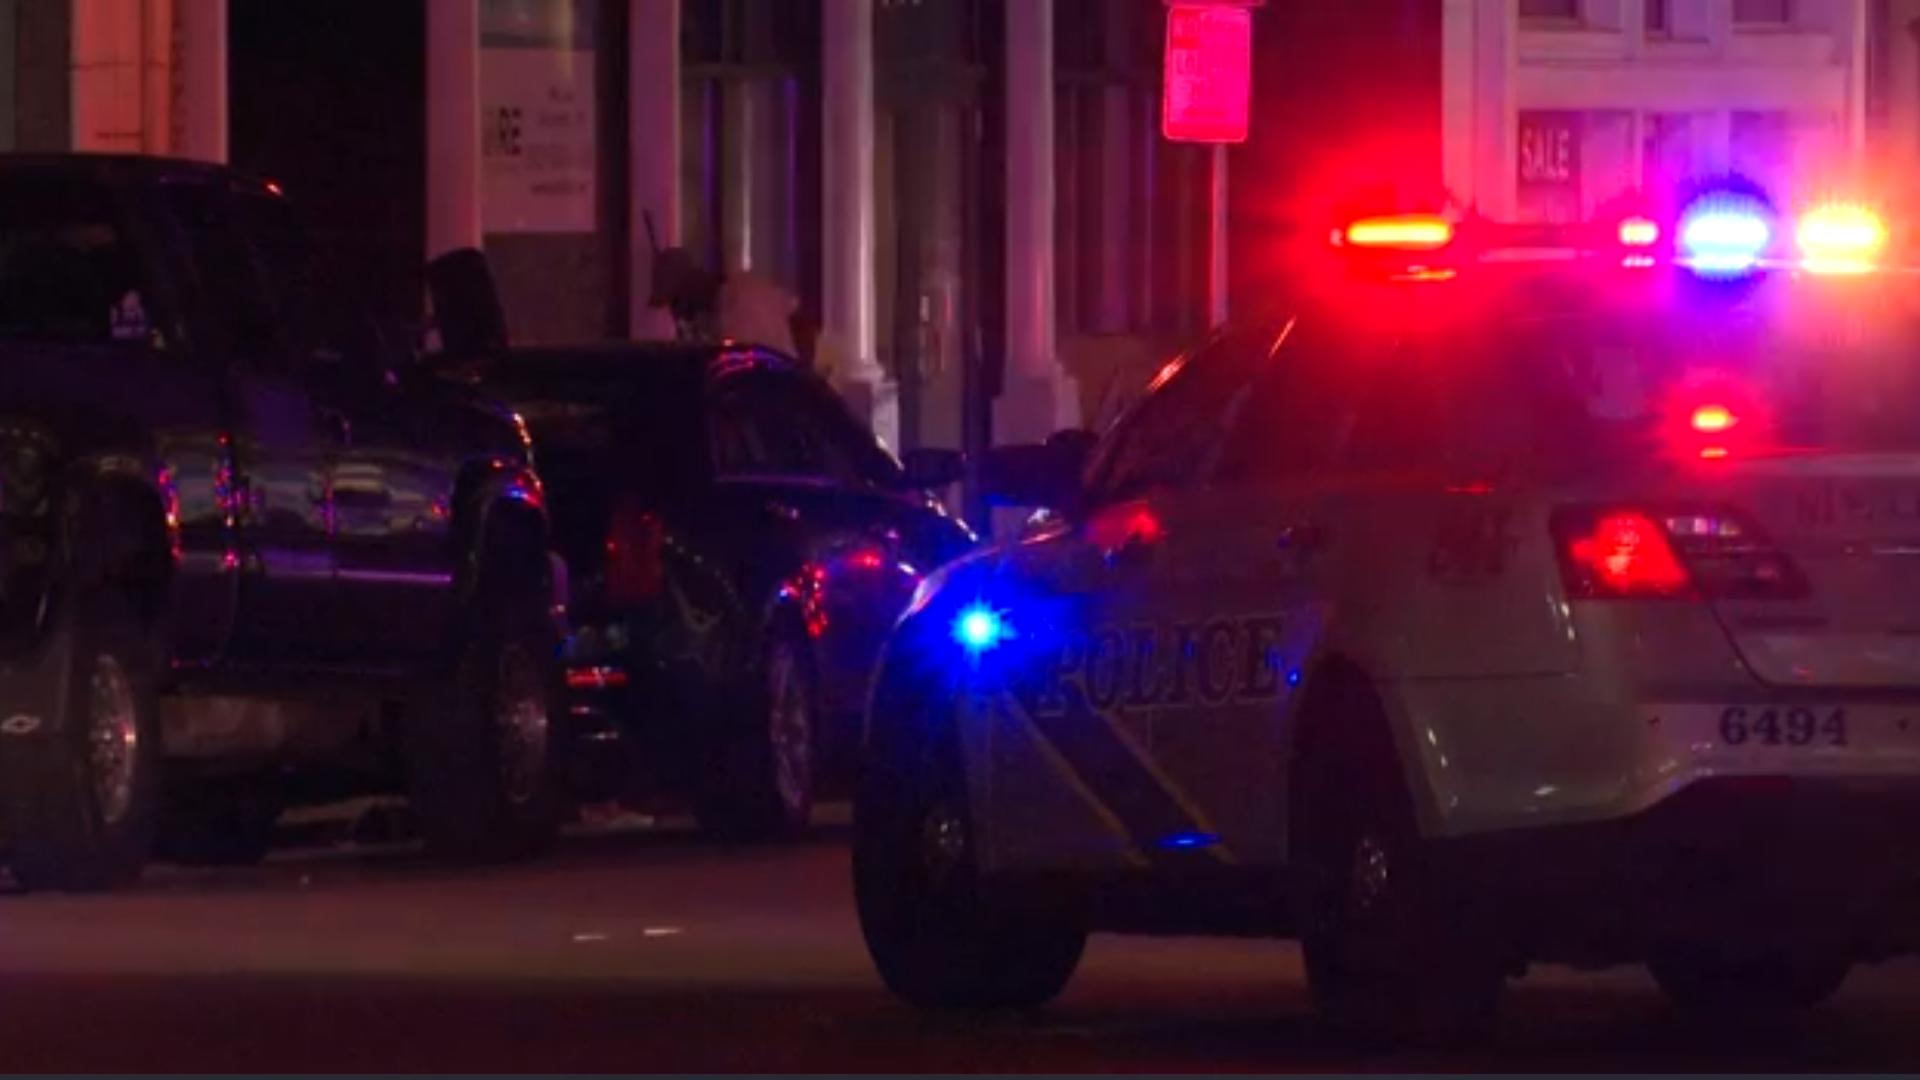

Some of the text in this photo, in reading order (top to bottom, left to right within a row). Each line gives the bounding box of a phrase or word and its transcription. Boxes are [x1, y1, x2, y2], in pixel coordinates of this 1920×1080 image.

[1520, 127, 1570, 182] SALE
[1037, 611, 1286, 717] POLICE
[1719, 706, 1849, 747] 6494
